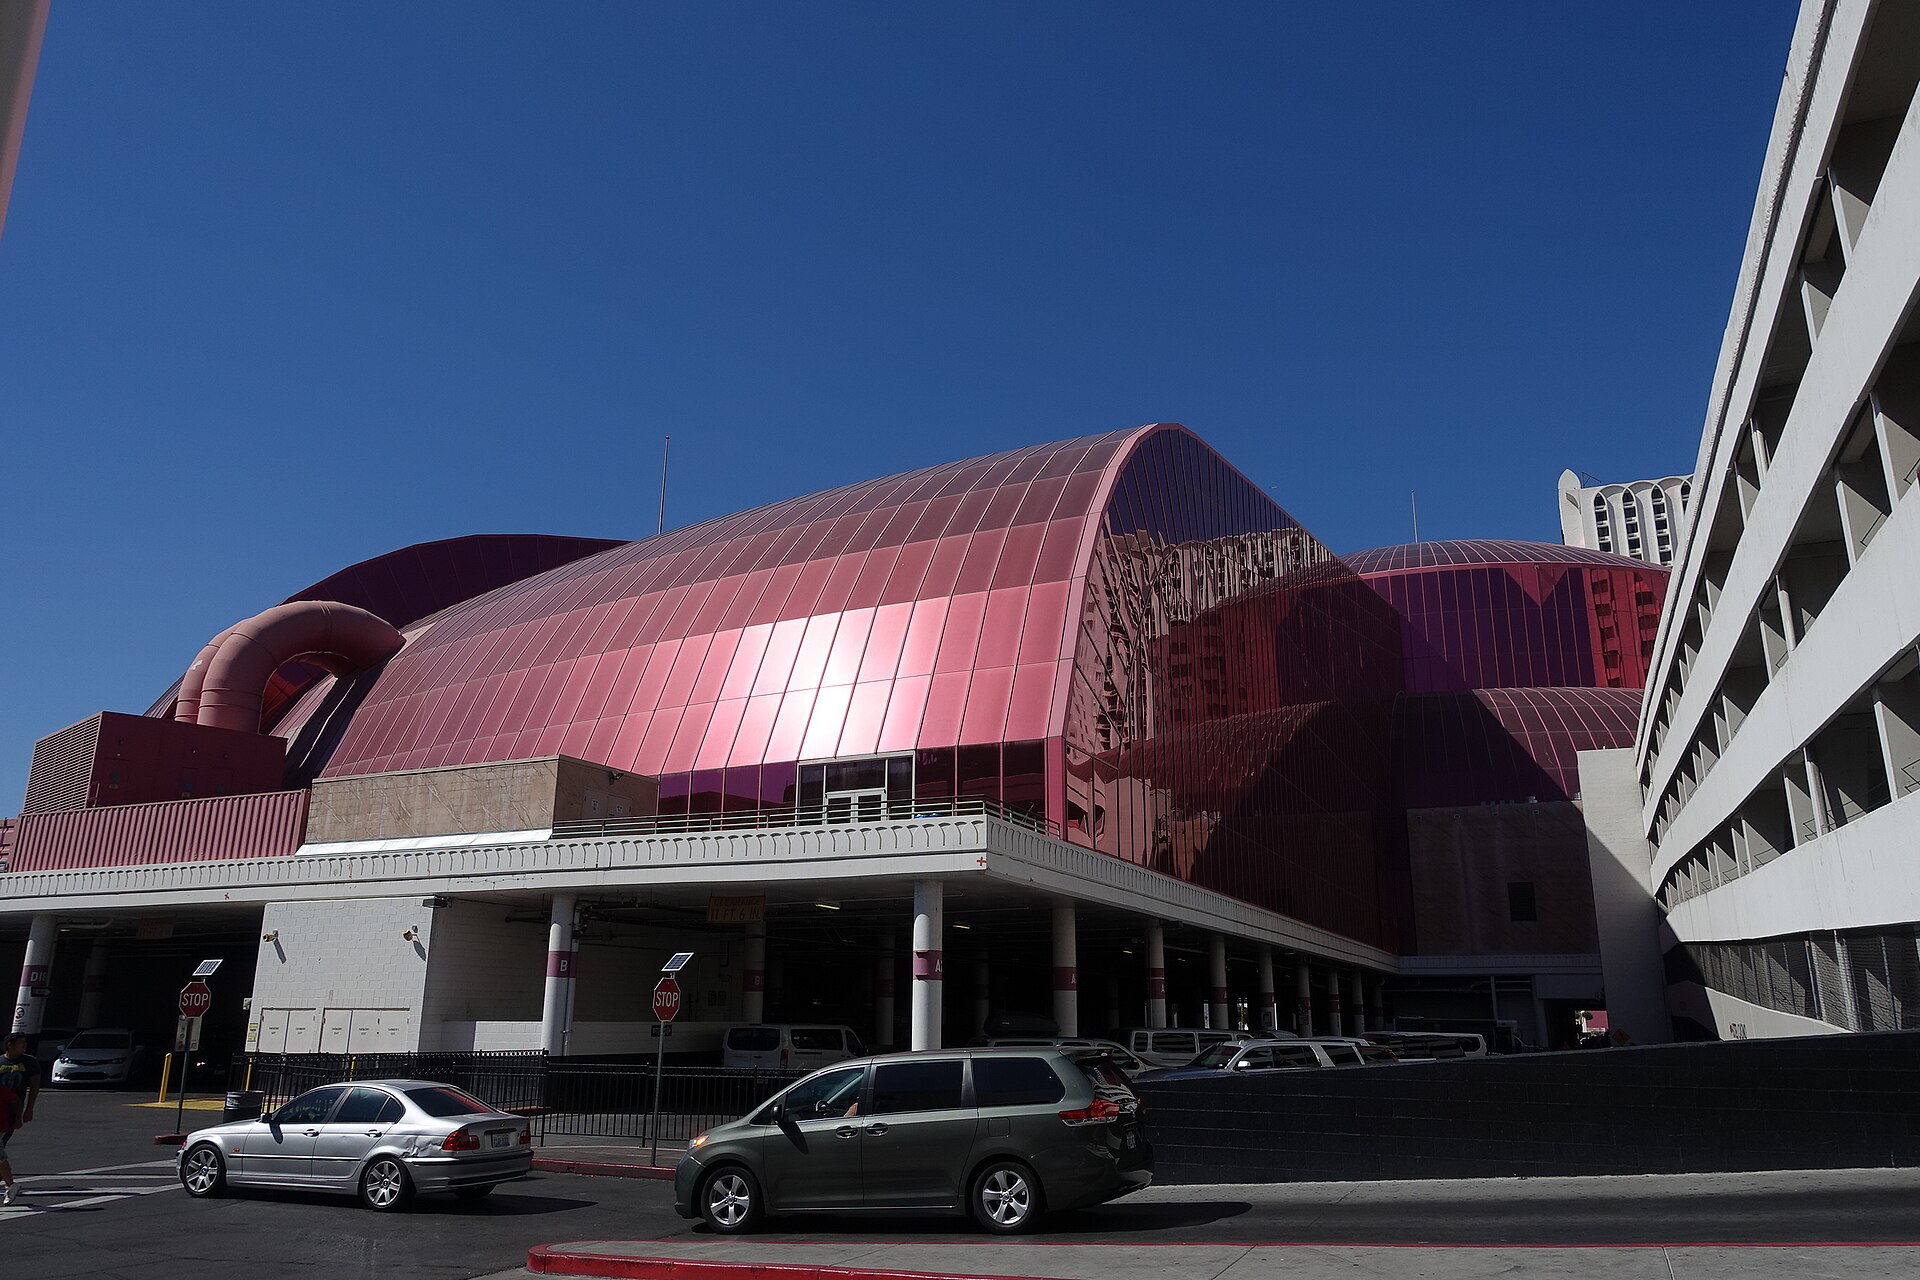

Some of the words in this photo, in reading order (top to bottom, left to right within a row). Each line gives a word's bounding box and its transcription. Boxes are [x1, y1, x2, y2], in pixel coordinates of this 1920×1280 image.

[739, 908, 745, 920] 6
[182, 993, 209, 1006] STOP
[655, 991, 679, 1007] STOP
